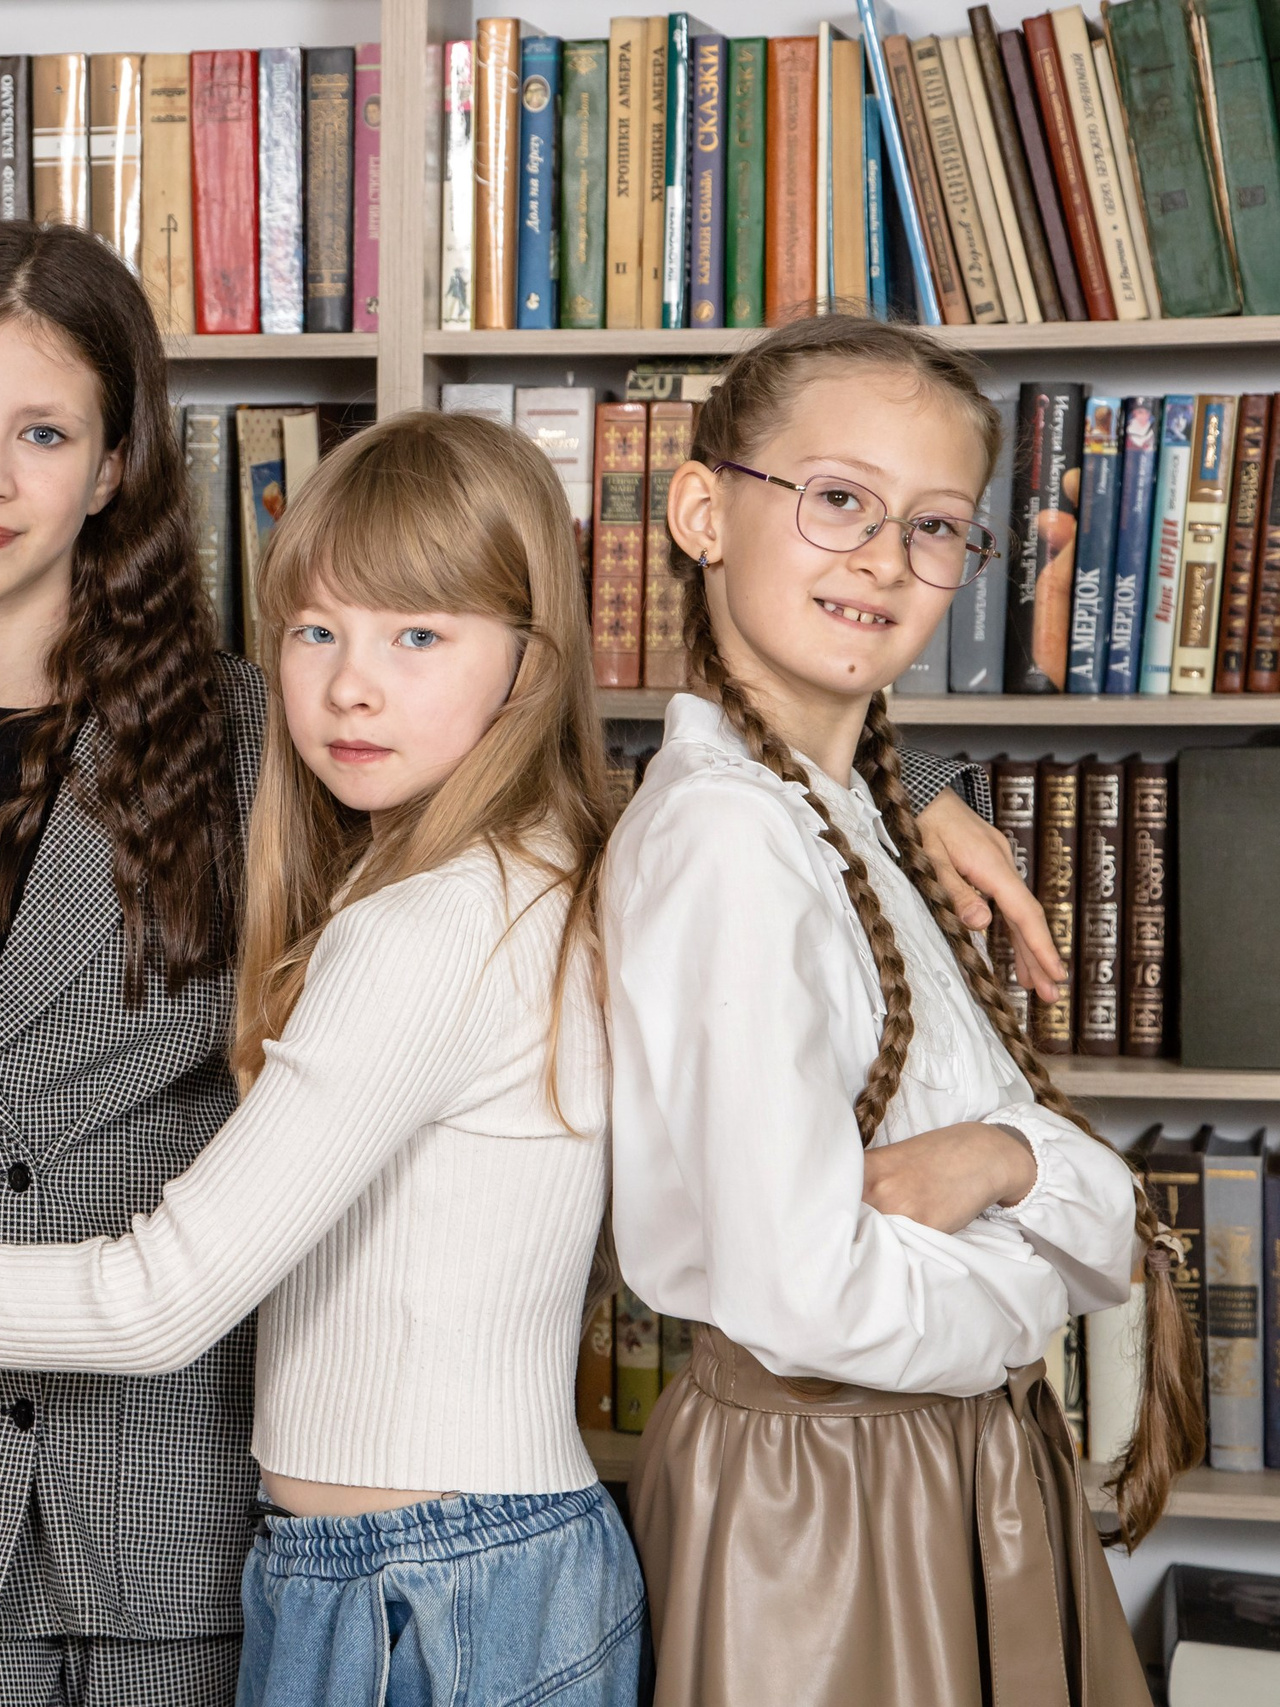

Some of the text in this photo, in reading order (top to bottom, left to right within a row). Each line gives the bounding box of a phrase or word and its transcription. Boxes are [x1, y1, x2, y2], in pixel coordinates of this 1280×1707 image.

[0, 74, 15, 159] БАЛЬЗАМО
[696, 43, 719, 153] СКАЗКИ
[922, 66, 947, 109] БЕГУН
[1073, 52, 1097, 119] ХРАНИМЫЙ
[616, 40, 632, 199] ХРОНИКИ АМБЕРА
[650, 45, 666, 203] ХРОНИКИ АМБЕРА
[1089, 122, 1109, 177] БЕРЕЖНО
[525, 134, 544, 235] Дом на берегу
[933, 113, 970, 202] СЕРЕБРЯНЫЙ
[698, 226, 712, 285] КАРМЕН
[1158, 516, 1180, 579] МЕРДОК
[1071, 566, 1104, 653] МЕРДОК
[1110, 572, 1138, 677] А. МЕРДОК
[1070, 657, 1094, 680] А.
[1149, 838, 1165, 900] СКОТТ
[1088, 959, 1114, 984] 15
[1136, 962, 1162, 987] 16
